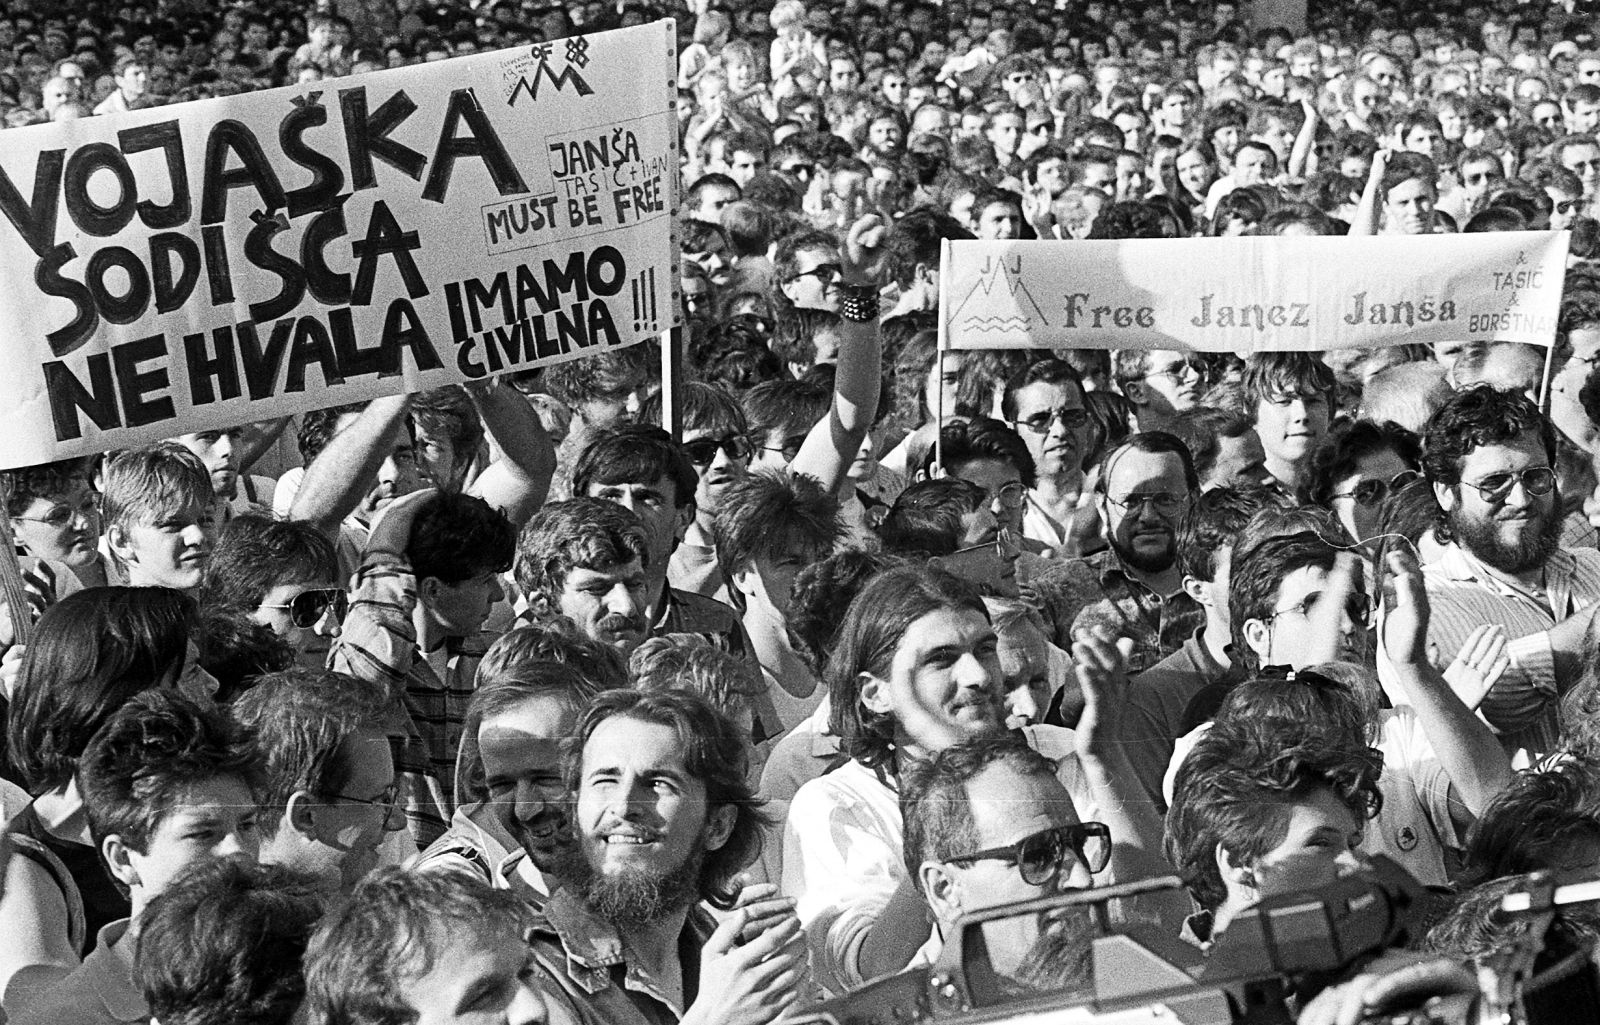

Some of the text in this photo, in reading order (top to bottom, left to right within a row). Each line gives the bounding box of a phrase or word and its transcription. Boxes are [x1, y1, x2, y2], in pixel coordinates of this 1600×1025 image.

[0, 86, 531, 258] VOJAŠKA
[549, 127, 640, 177] JANŠA
[487, 196, 559, 245] MUST
[568, 195, 602, 228] BE
[613, 176, 664, 225] FREE
[444, 245, 626, 345] IMAMO
[1062, 290, 1457, 331] Free Janez Janša
[42, 297, 445, 442] NE HVALA
[457, 298, 622, 379] CIVILNA
